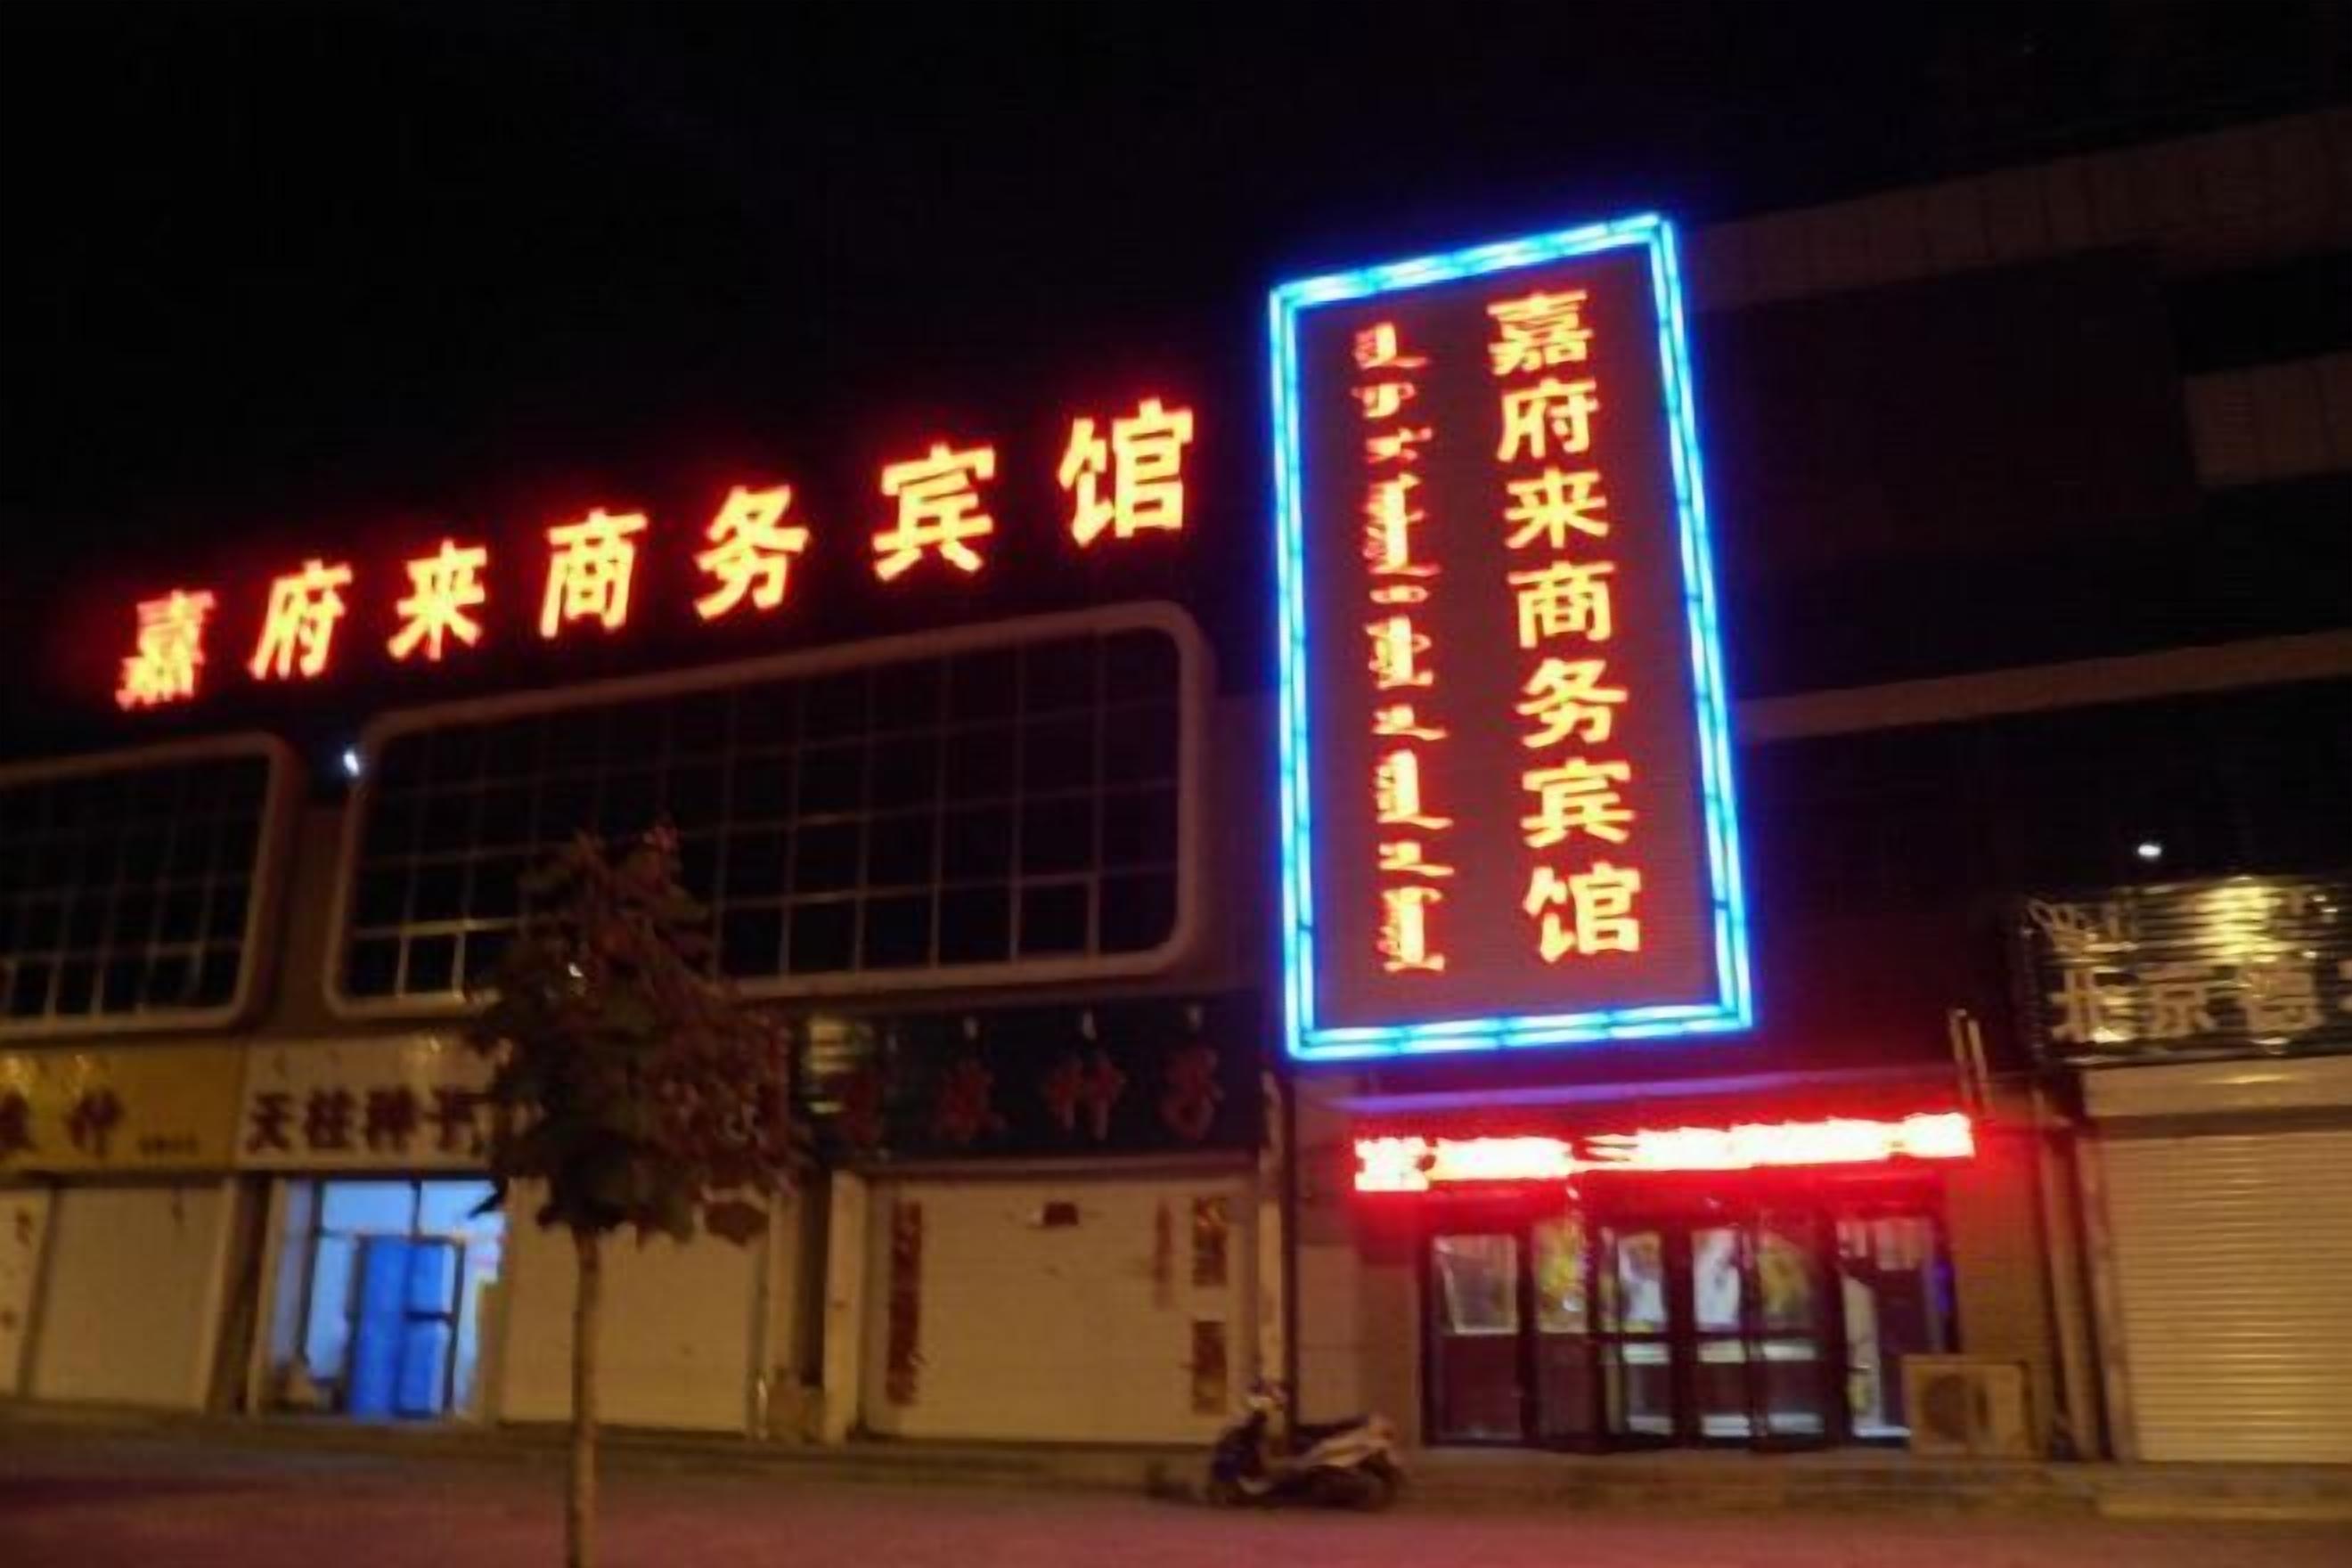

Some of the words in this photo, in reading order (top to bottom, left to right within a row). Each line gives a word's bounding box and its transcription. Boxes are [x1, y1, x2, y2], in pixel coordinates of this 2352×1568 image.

[116, 397, 1195, 710] 嘉府来商务宾馆
[1486, 287, 1644, 965] 嘉府来商务宾馆
